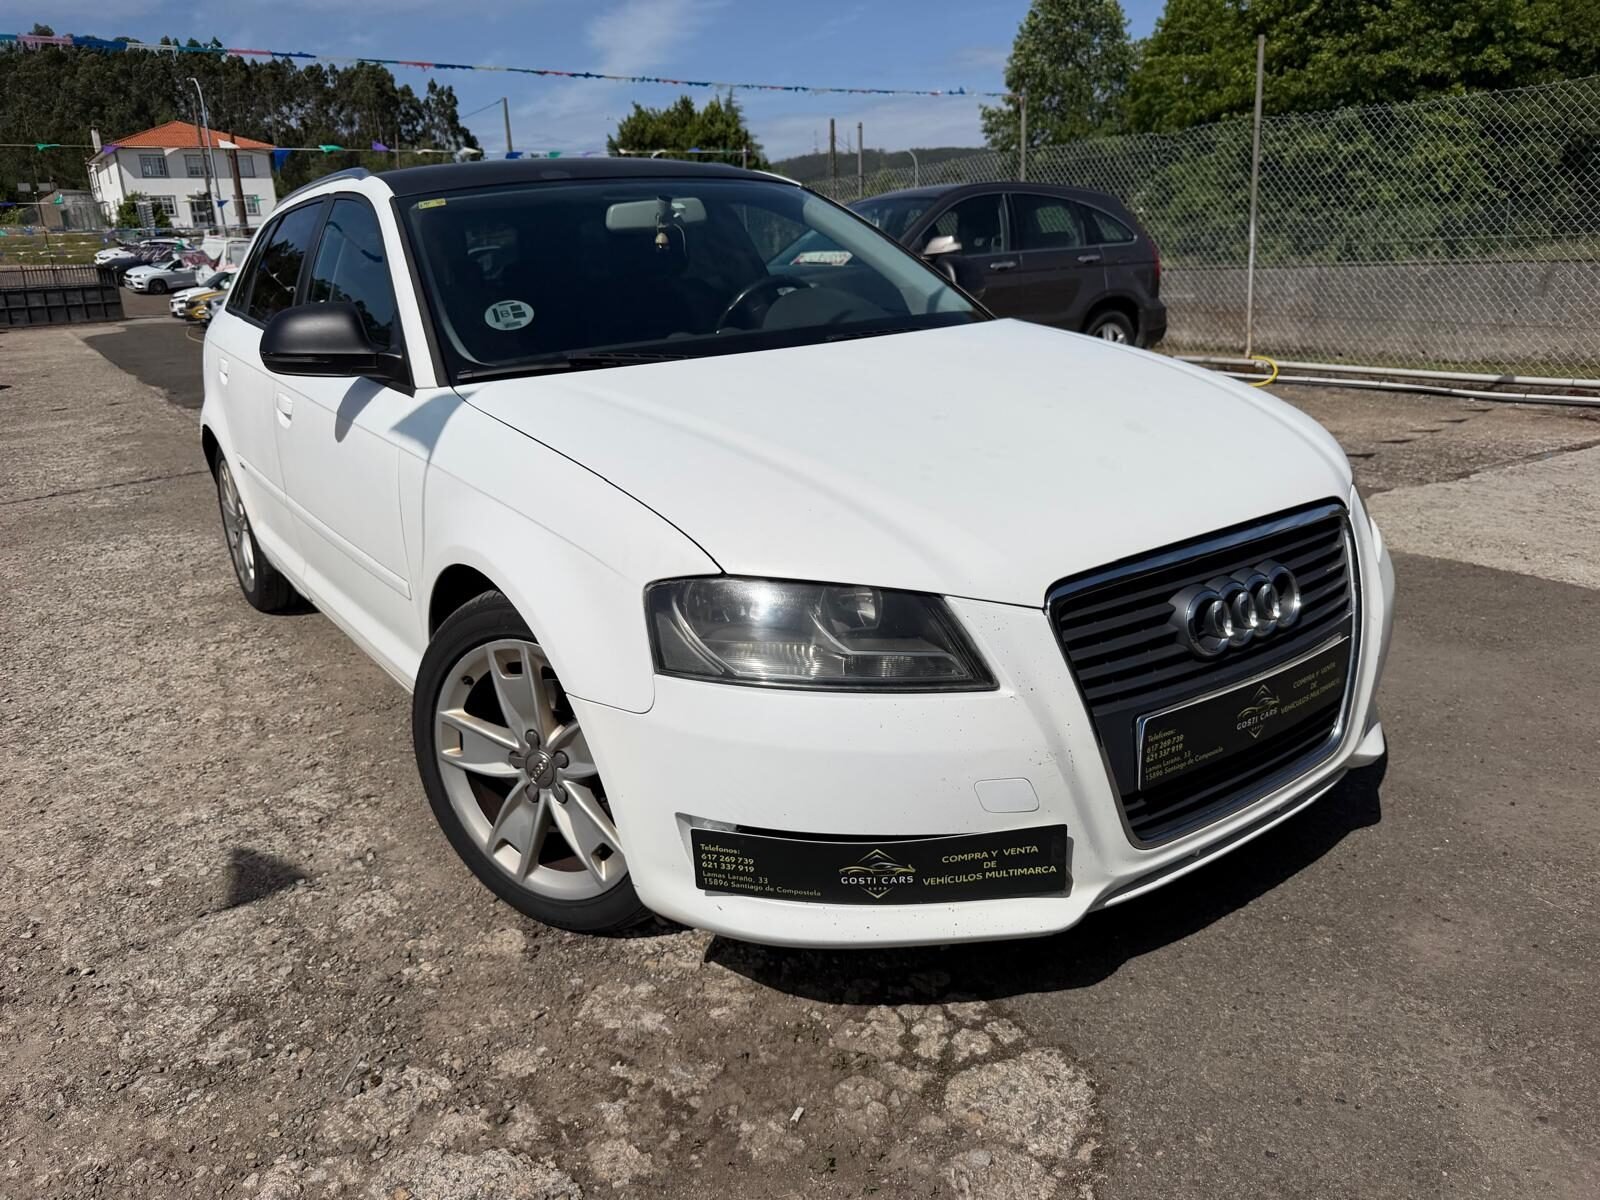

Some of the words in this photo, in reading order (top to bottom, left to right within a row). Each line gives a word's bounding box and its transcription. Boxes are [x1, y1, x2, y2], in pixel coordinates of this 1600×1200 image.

[701, 853, 718, 861] 617
[719, 855, 736, 863] 269
[737, 857, 754, 865] 739
[941, 851, 989, 864] COMPRA
[991, 850, 999, 858] Y
[1003, 845, 1039, 857] VENTA
[702, 861, 718, 869] 621
[737, 865, 755, 873] 919
[983, 860, 997, 869] DE
[758, 876, 769, 884] 33
[881, 875, 914, 885] CARS
[922, 872, 983, 886] VEHÍCULOS
[985, 865, 1057, 880] MULTIMARCA
[703, 877, 729, 887] 15896
[731, 880, 763, 892] Santiago
[776, 886, 821, 897] Compostela
